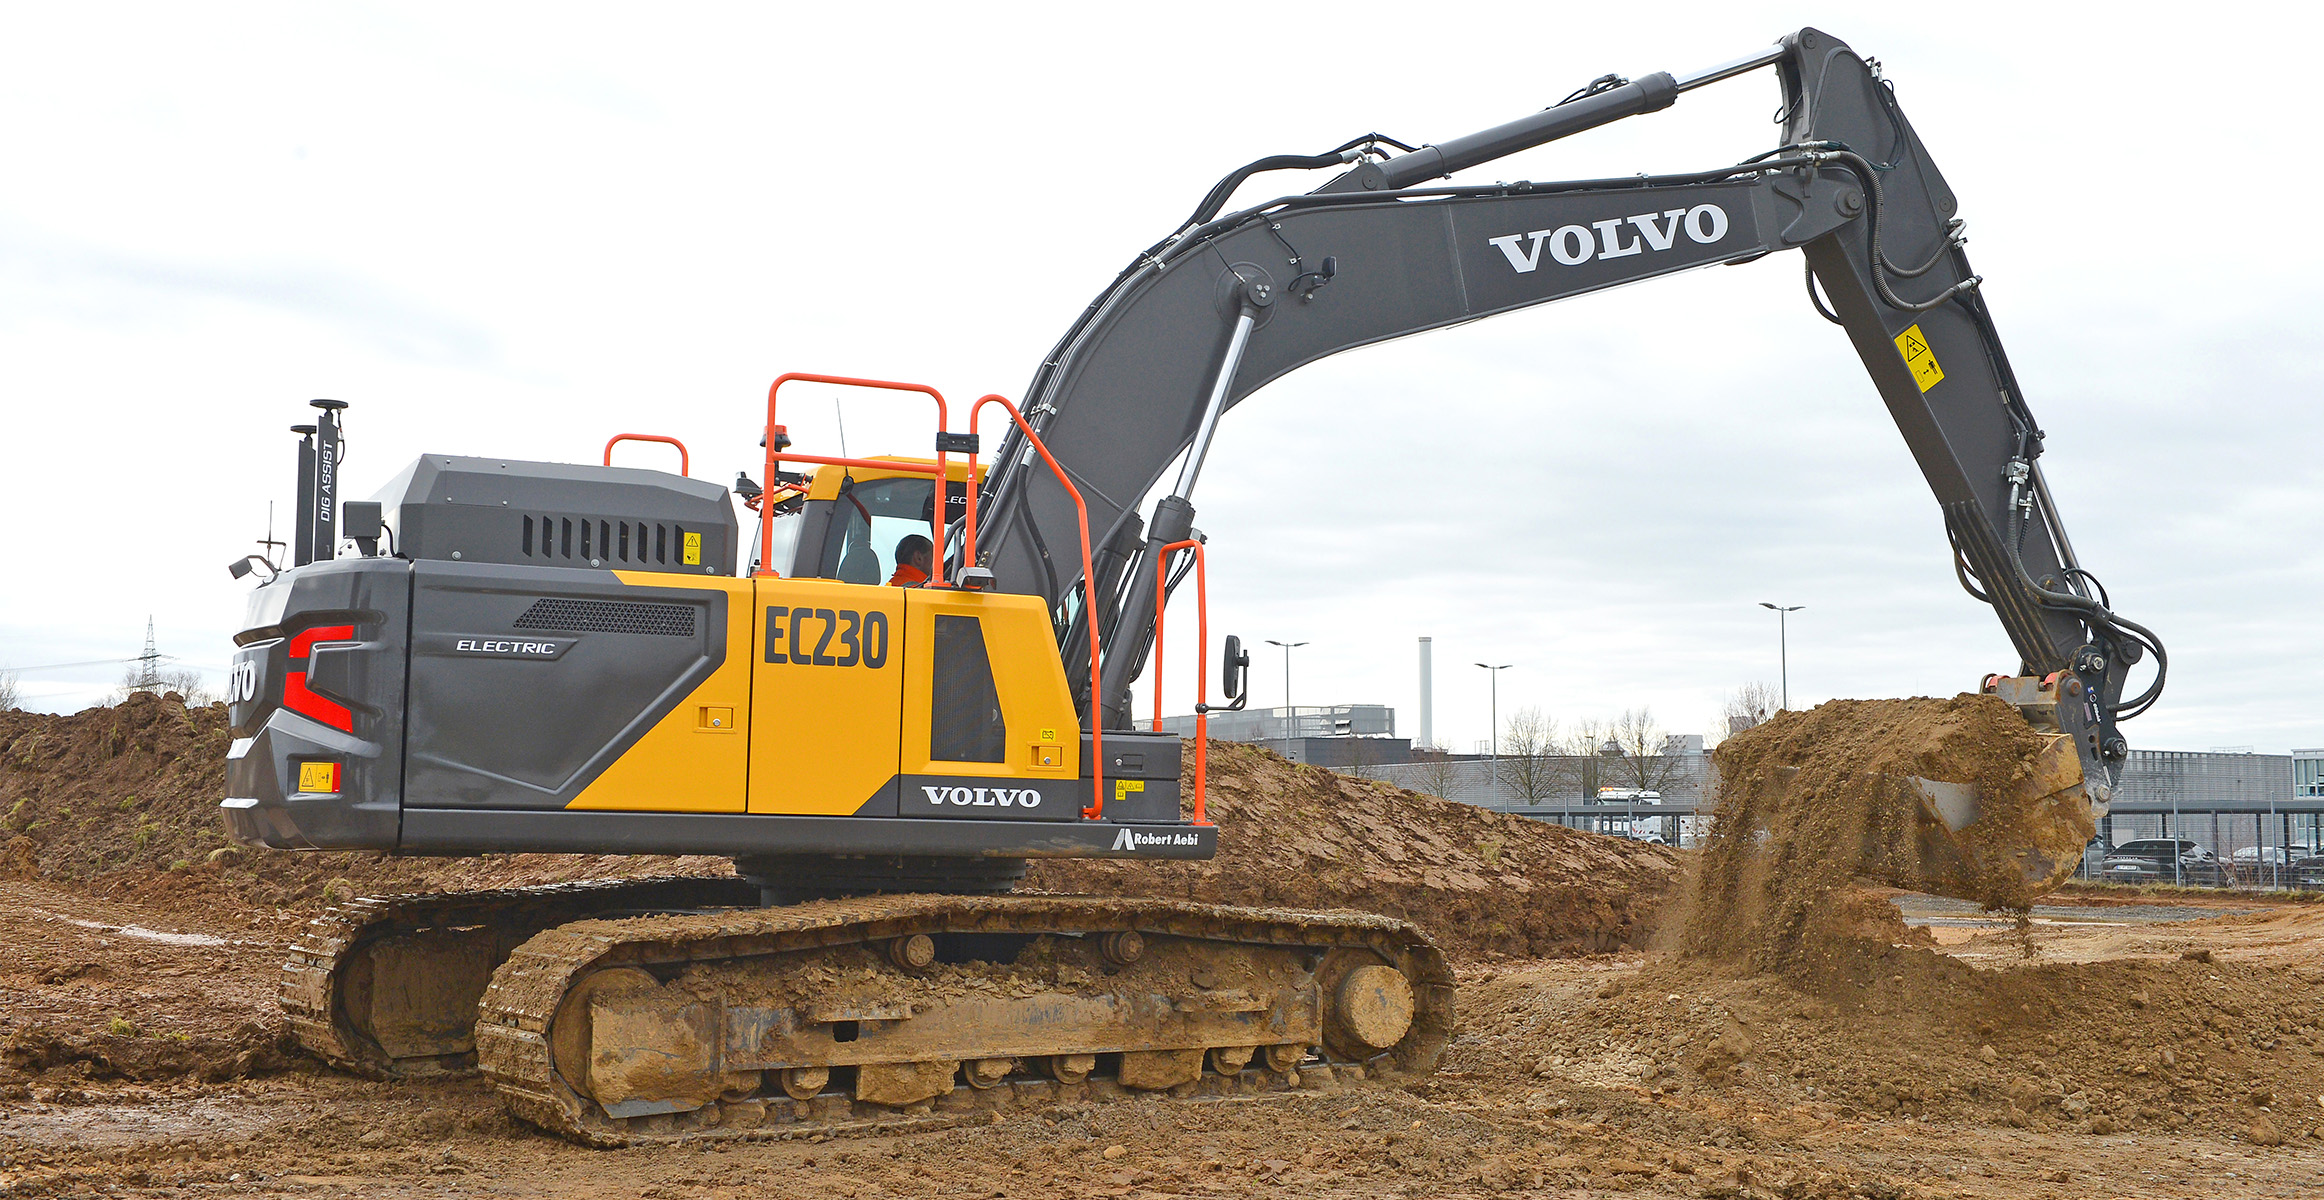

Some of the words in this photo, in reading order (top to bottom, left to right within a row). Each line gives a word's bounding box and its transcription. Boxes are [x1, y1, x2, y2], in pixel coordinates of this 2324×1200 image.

[1488, 203, 1729, 274] VOLVO
[321, 440, 333, 495] ASSIST
[320, 496, 331, 522] DIG
[456, 640, 556, 654] ELECTRIC
[764, 605, 889, 669] EC230
[921, 786, 1041, 808] VOLVO
[1134, 833, 1172, 845] Robert
[1173, 833, 1199, 846] Aebi
